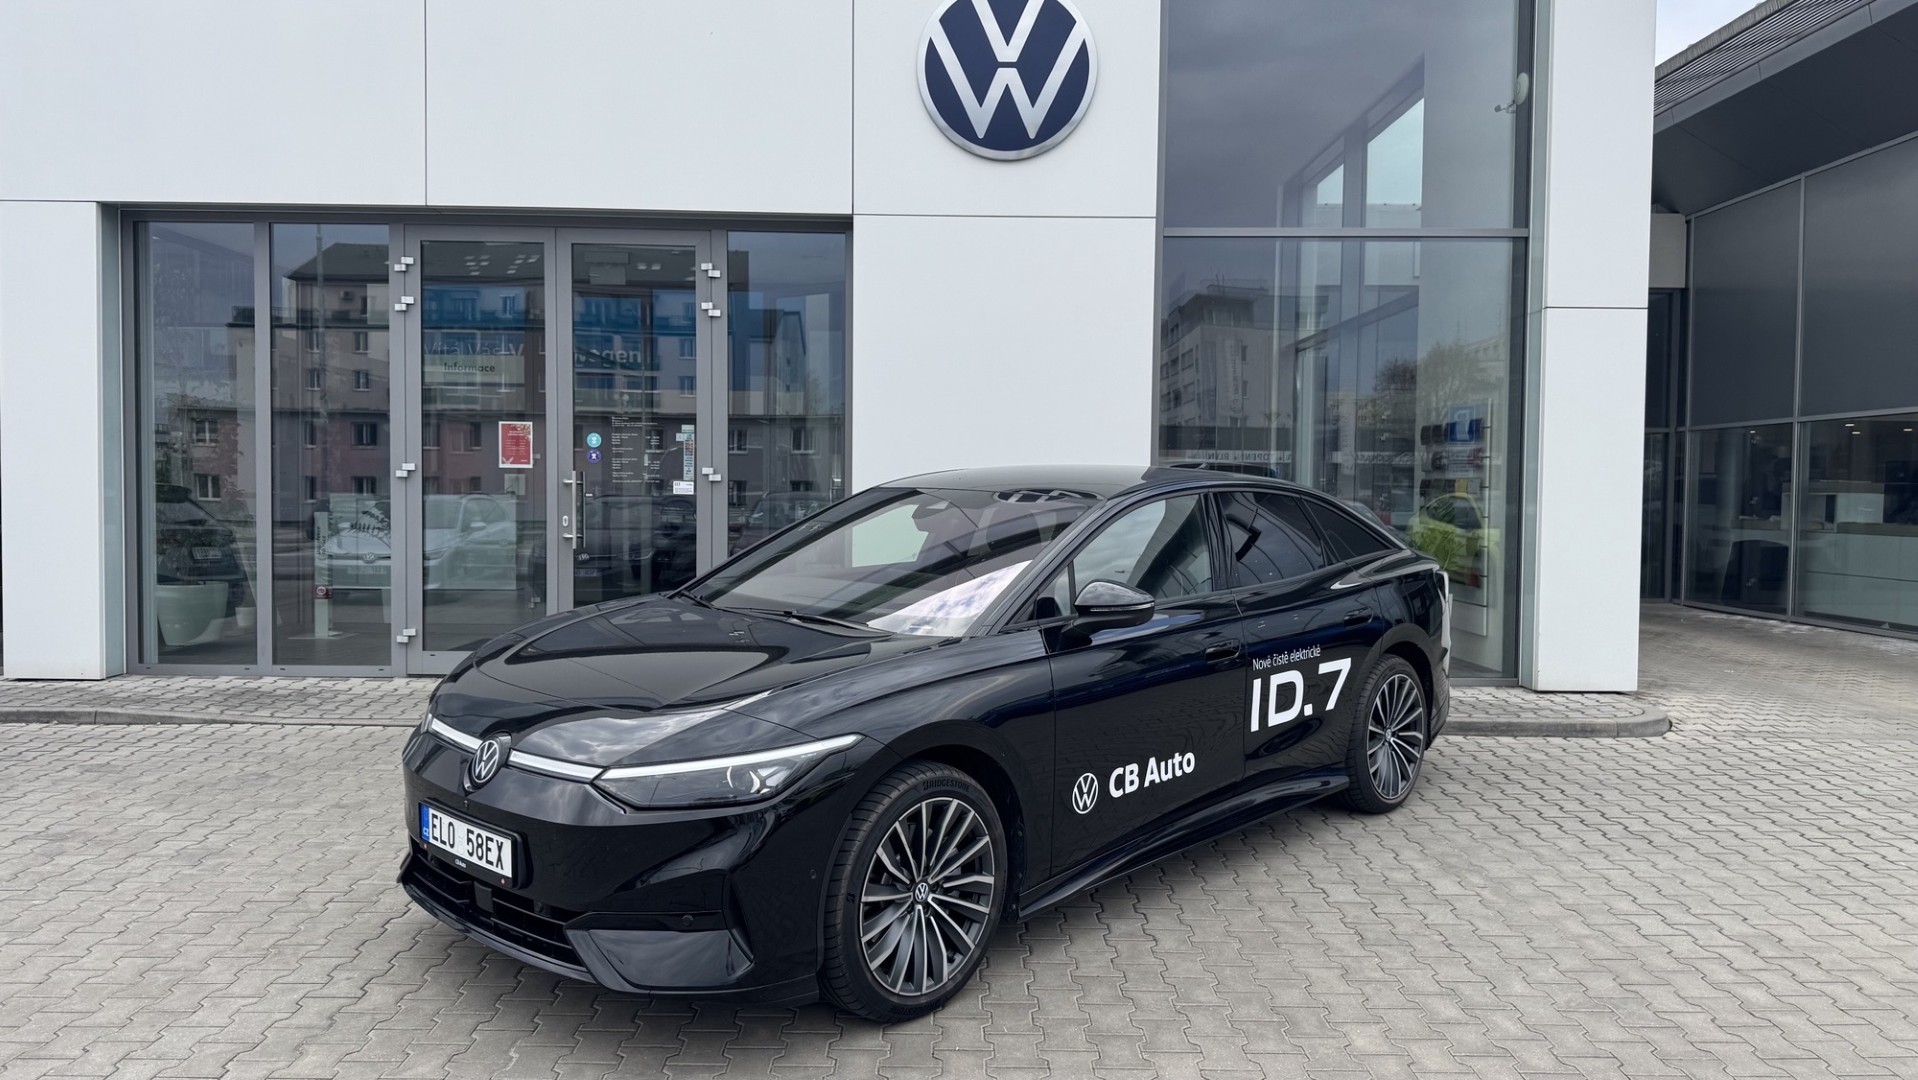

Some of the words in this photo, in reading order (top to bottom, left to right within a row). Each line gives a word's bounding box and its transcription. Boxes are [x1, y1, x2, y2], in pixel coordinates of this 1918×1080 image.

[443, 361, 496, 373] Informace
[1252, 655, 1271, 671] Nové
[1272, 651, 1289, 667] čistě
[1289, 644, 1321, 663] elektrické
[473, 740, 499, 783] VW
[1108, 762, 1140, 798] CB
[1143, 752, 1196, 788] Auto
[922, 779, 971, 793] BRIDGESTONE
[1072, 772, 1099, 815] VW
[466, 827, 504, 871] 58EX
